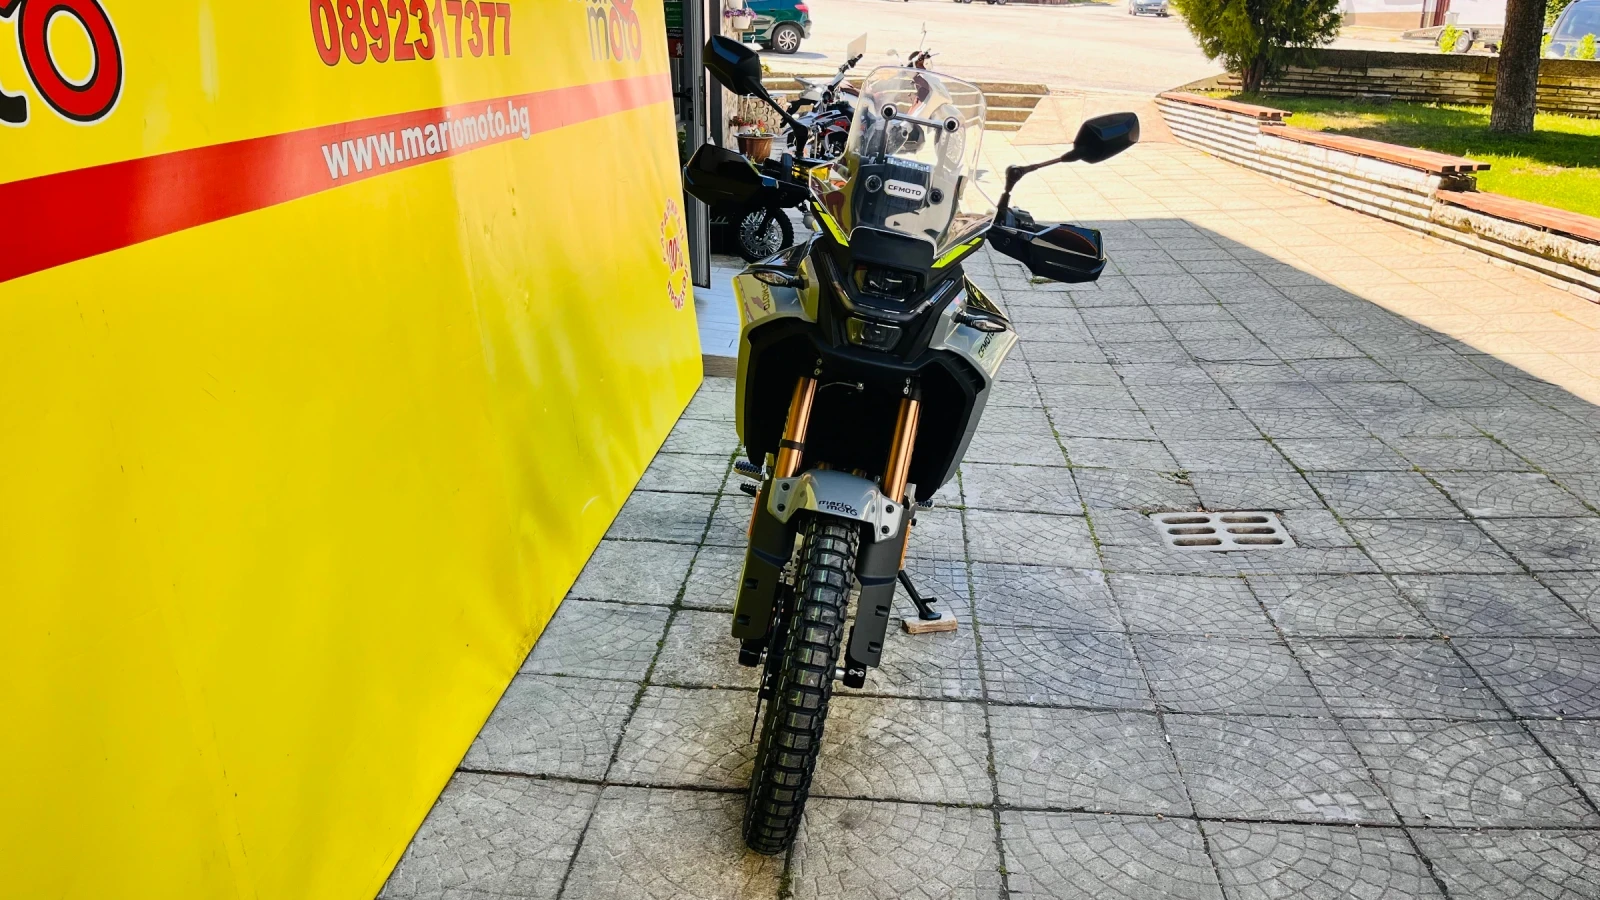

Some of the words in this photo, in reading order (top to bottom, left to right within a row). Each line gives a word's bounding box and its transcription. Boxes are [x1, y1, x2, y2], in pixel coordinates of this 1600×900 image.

[310, 0, 511, 66] 0892317377
[321, 100, 530, 180] www.mariomoto.bg
[888, 184, 922, 196] CFMOTO
[818, 500, 852, 510] mario
[826, 504, 858, 516] moto
